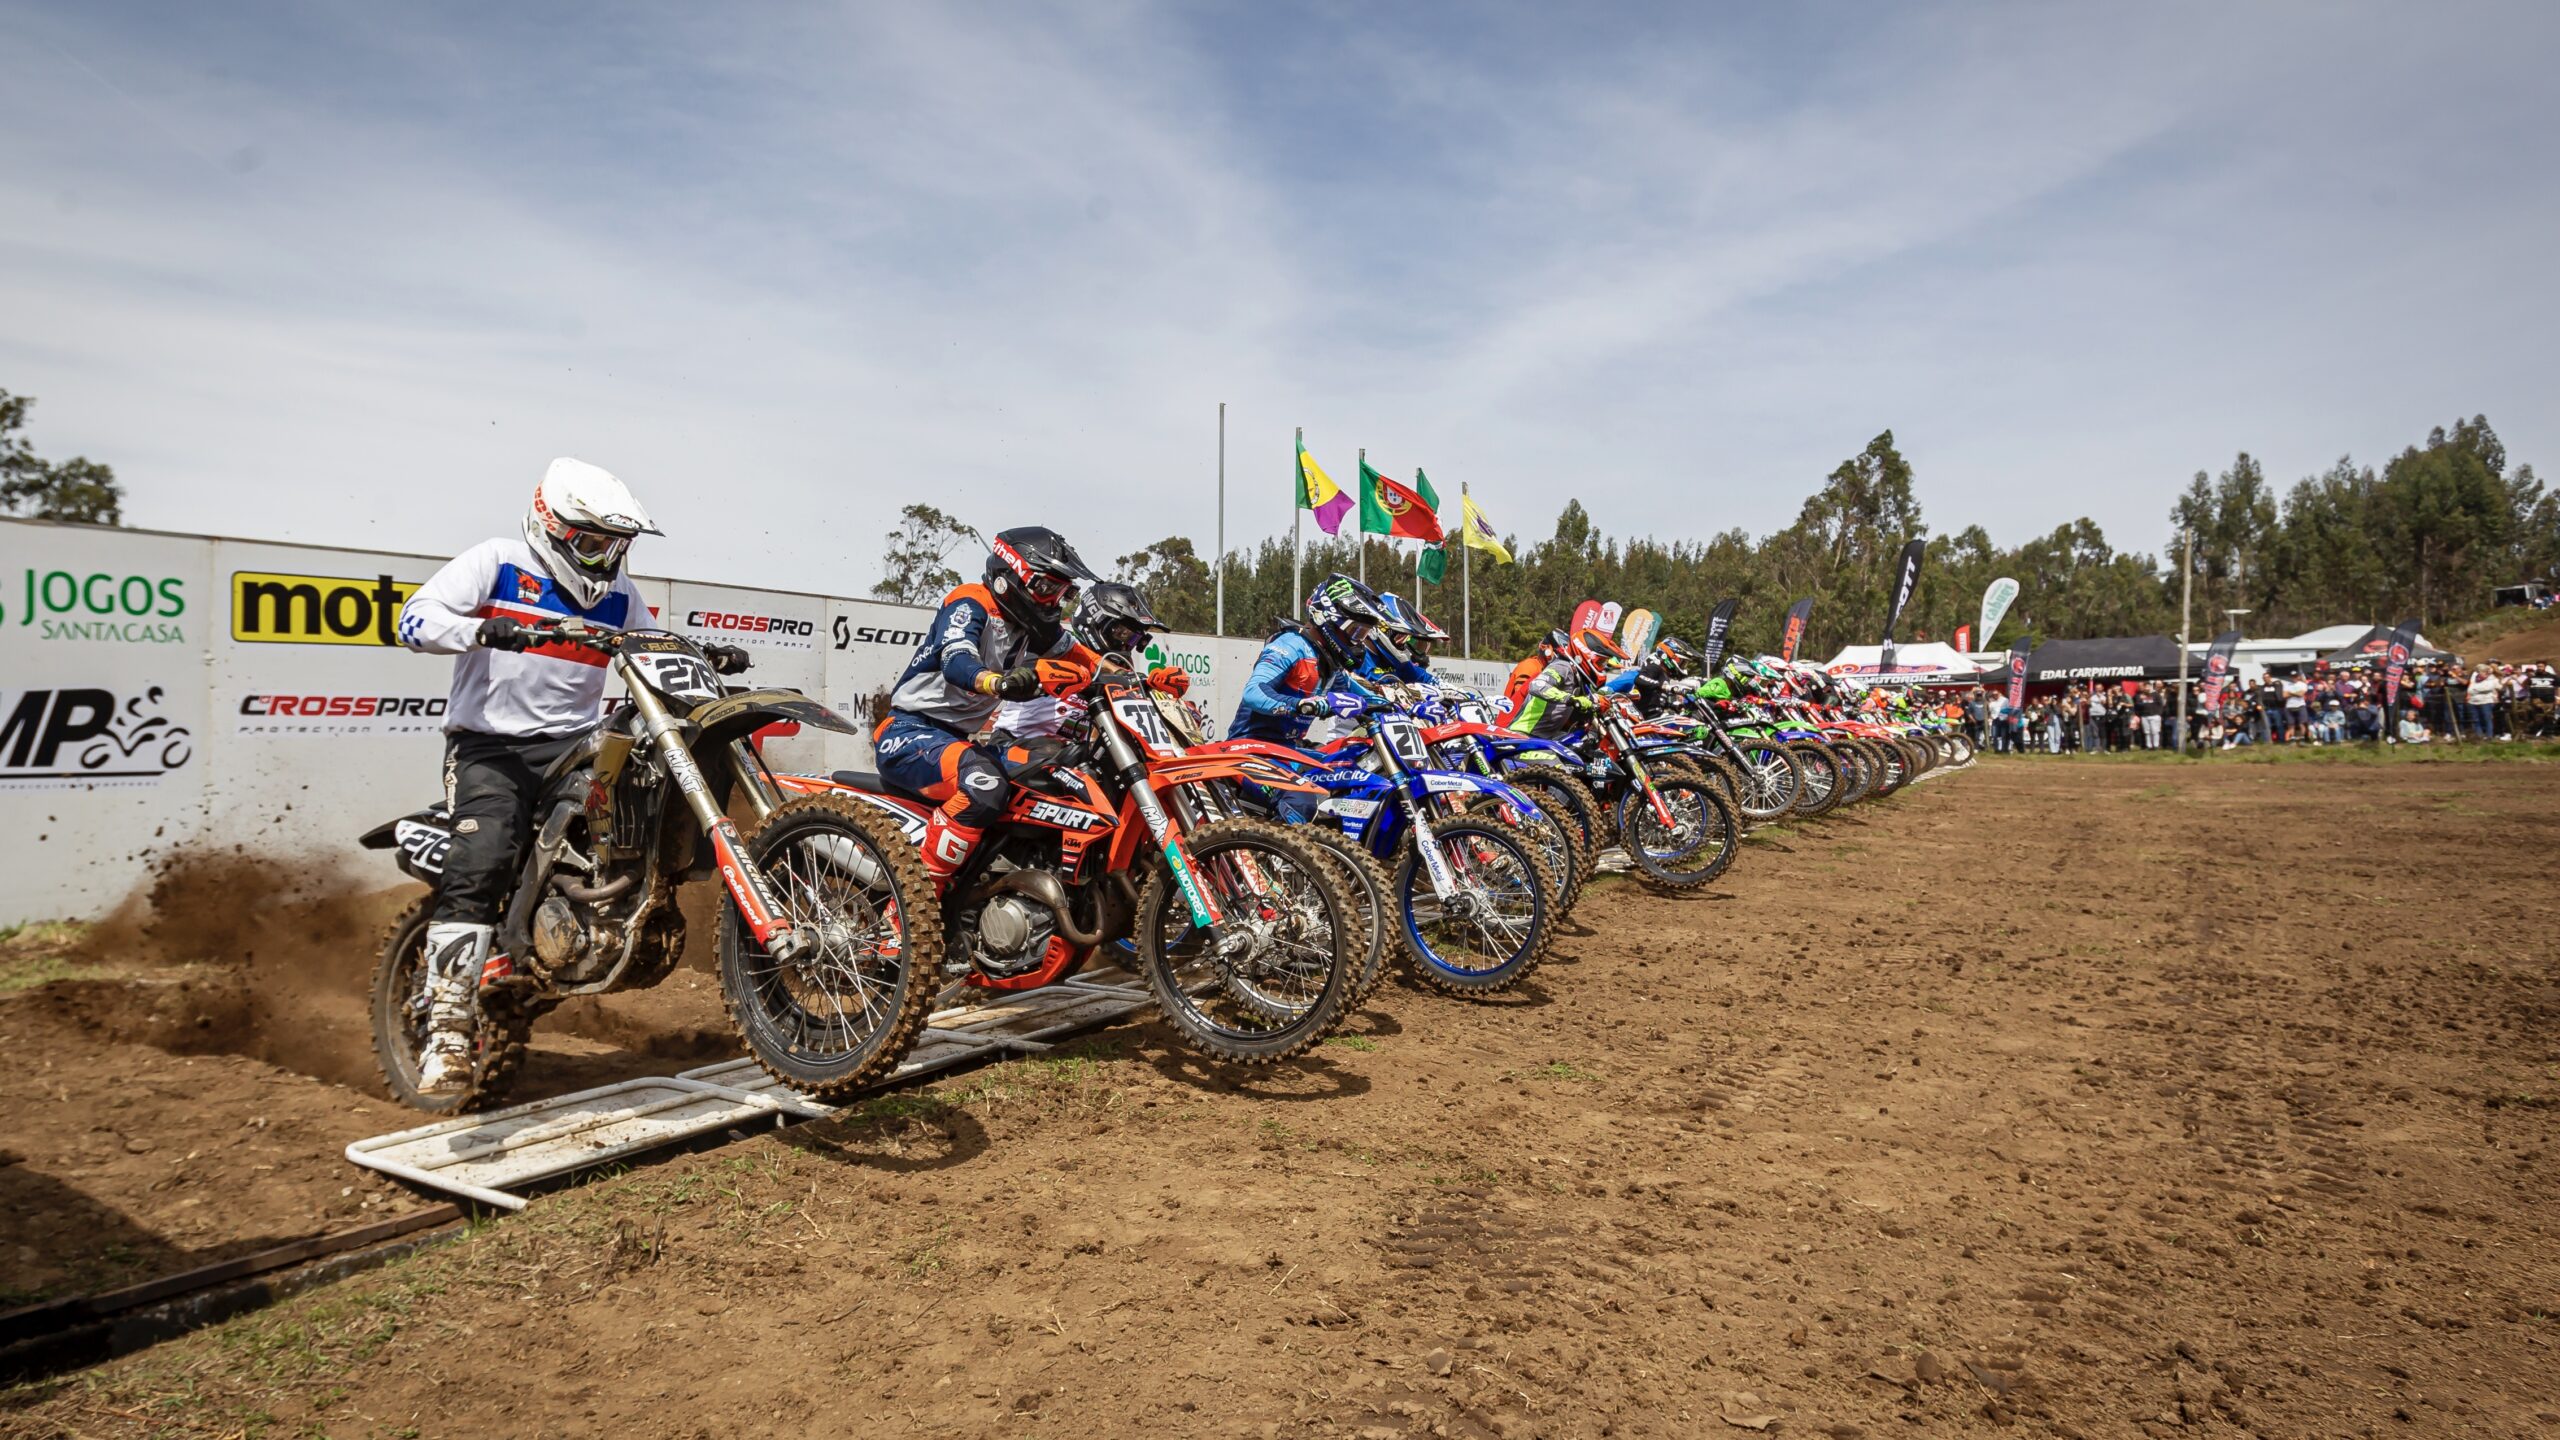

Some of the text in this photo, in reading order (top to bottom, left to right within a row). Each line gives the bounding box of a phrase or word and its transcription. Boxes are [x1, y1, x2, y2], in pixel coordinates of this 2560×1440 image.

[21, 569, 185, 627] JOGOS
[241, 575, 404, 645] mot
[41, 620, 185, 643] SANTACASA
[687, 611, 814, 636] CROSSPRO
[687, 634, 812, 649] PROTECTION PARTS
[854, 627, 927, 646] SCOT
[2040, 665, 2144, 680] EDAL CARPINTARIA
[239, 695, 449, 717] CROSSPRO
[238, 725, 371, 734] PROTECTION
[1063, 837, 1081, 848] KTM
[733, 844, 783, 917] MICHELIN
[1177, 868, 1207, 919] MOTOREX
